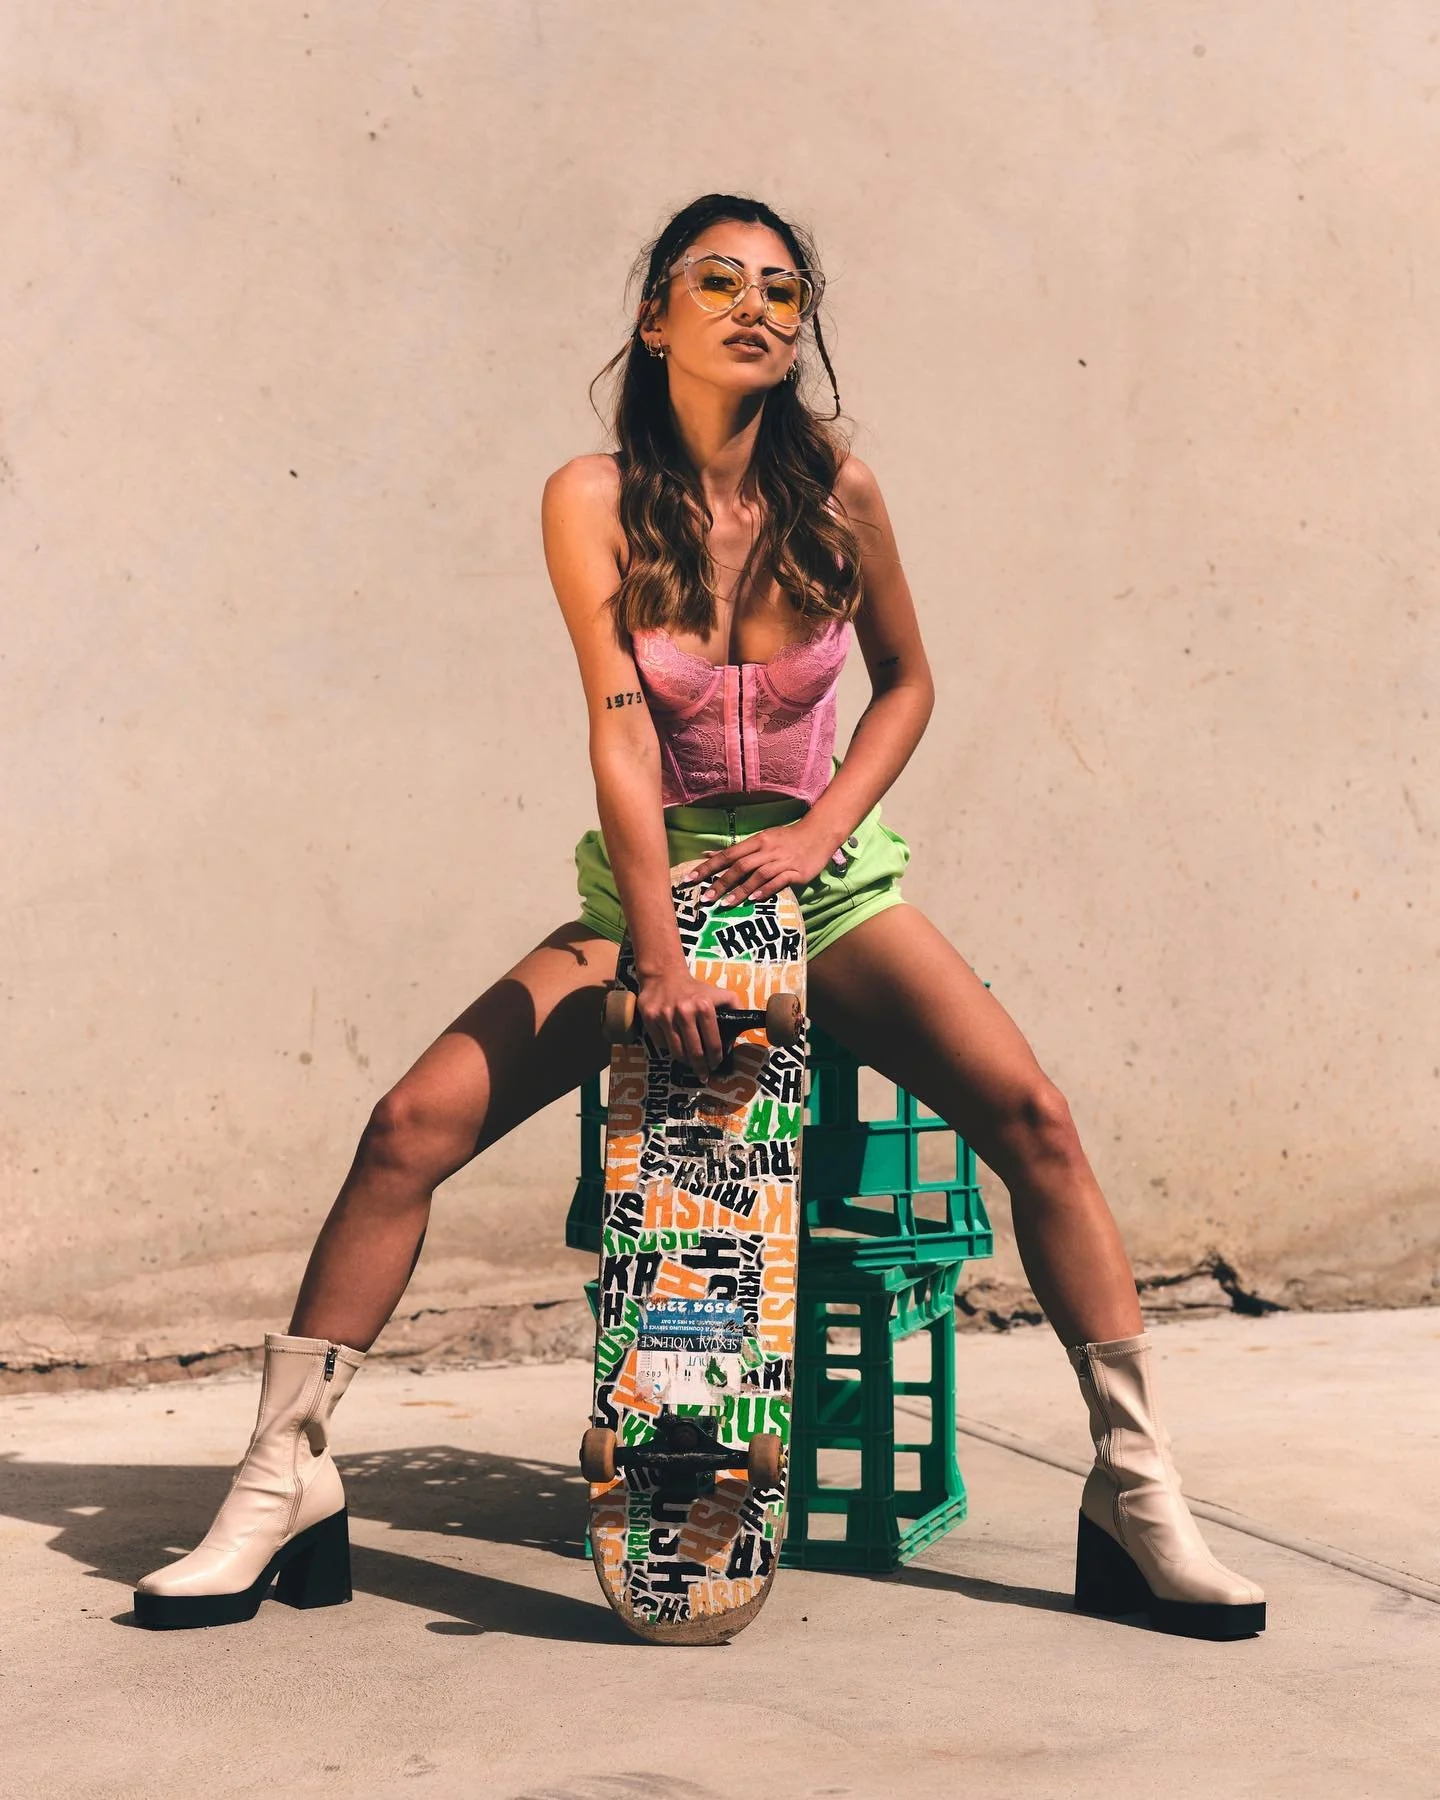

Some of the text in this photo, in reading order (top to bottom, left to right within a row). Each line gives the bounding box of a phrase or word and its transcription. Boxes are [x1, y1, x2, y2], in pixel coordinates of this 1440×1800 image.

[606, 692, 642, 710] 1975
[706, 1140, 800, 1183] RUSH
[641, 1335, 740, 1351] SEXUAL VIOLENCE
[627, 1491, 650, 1560] KRUSH
